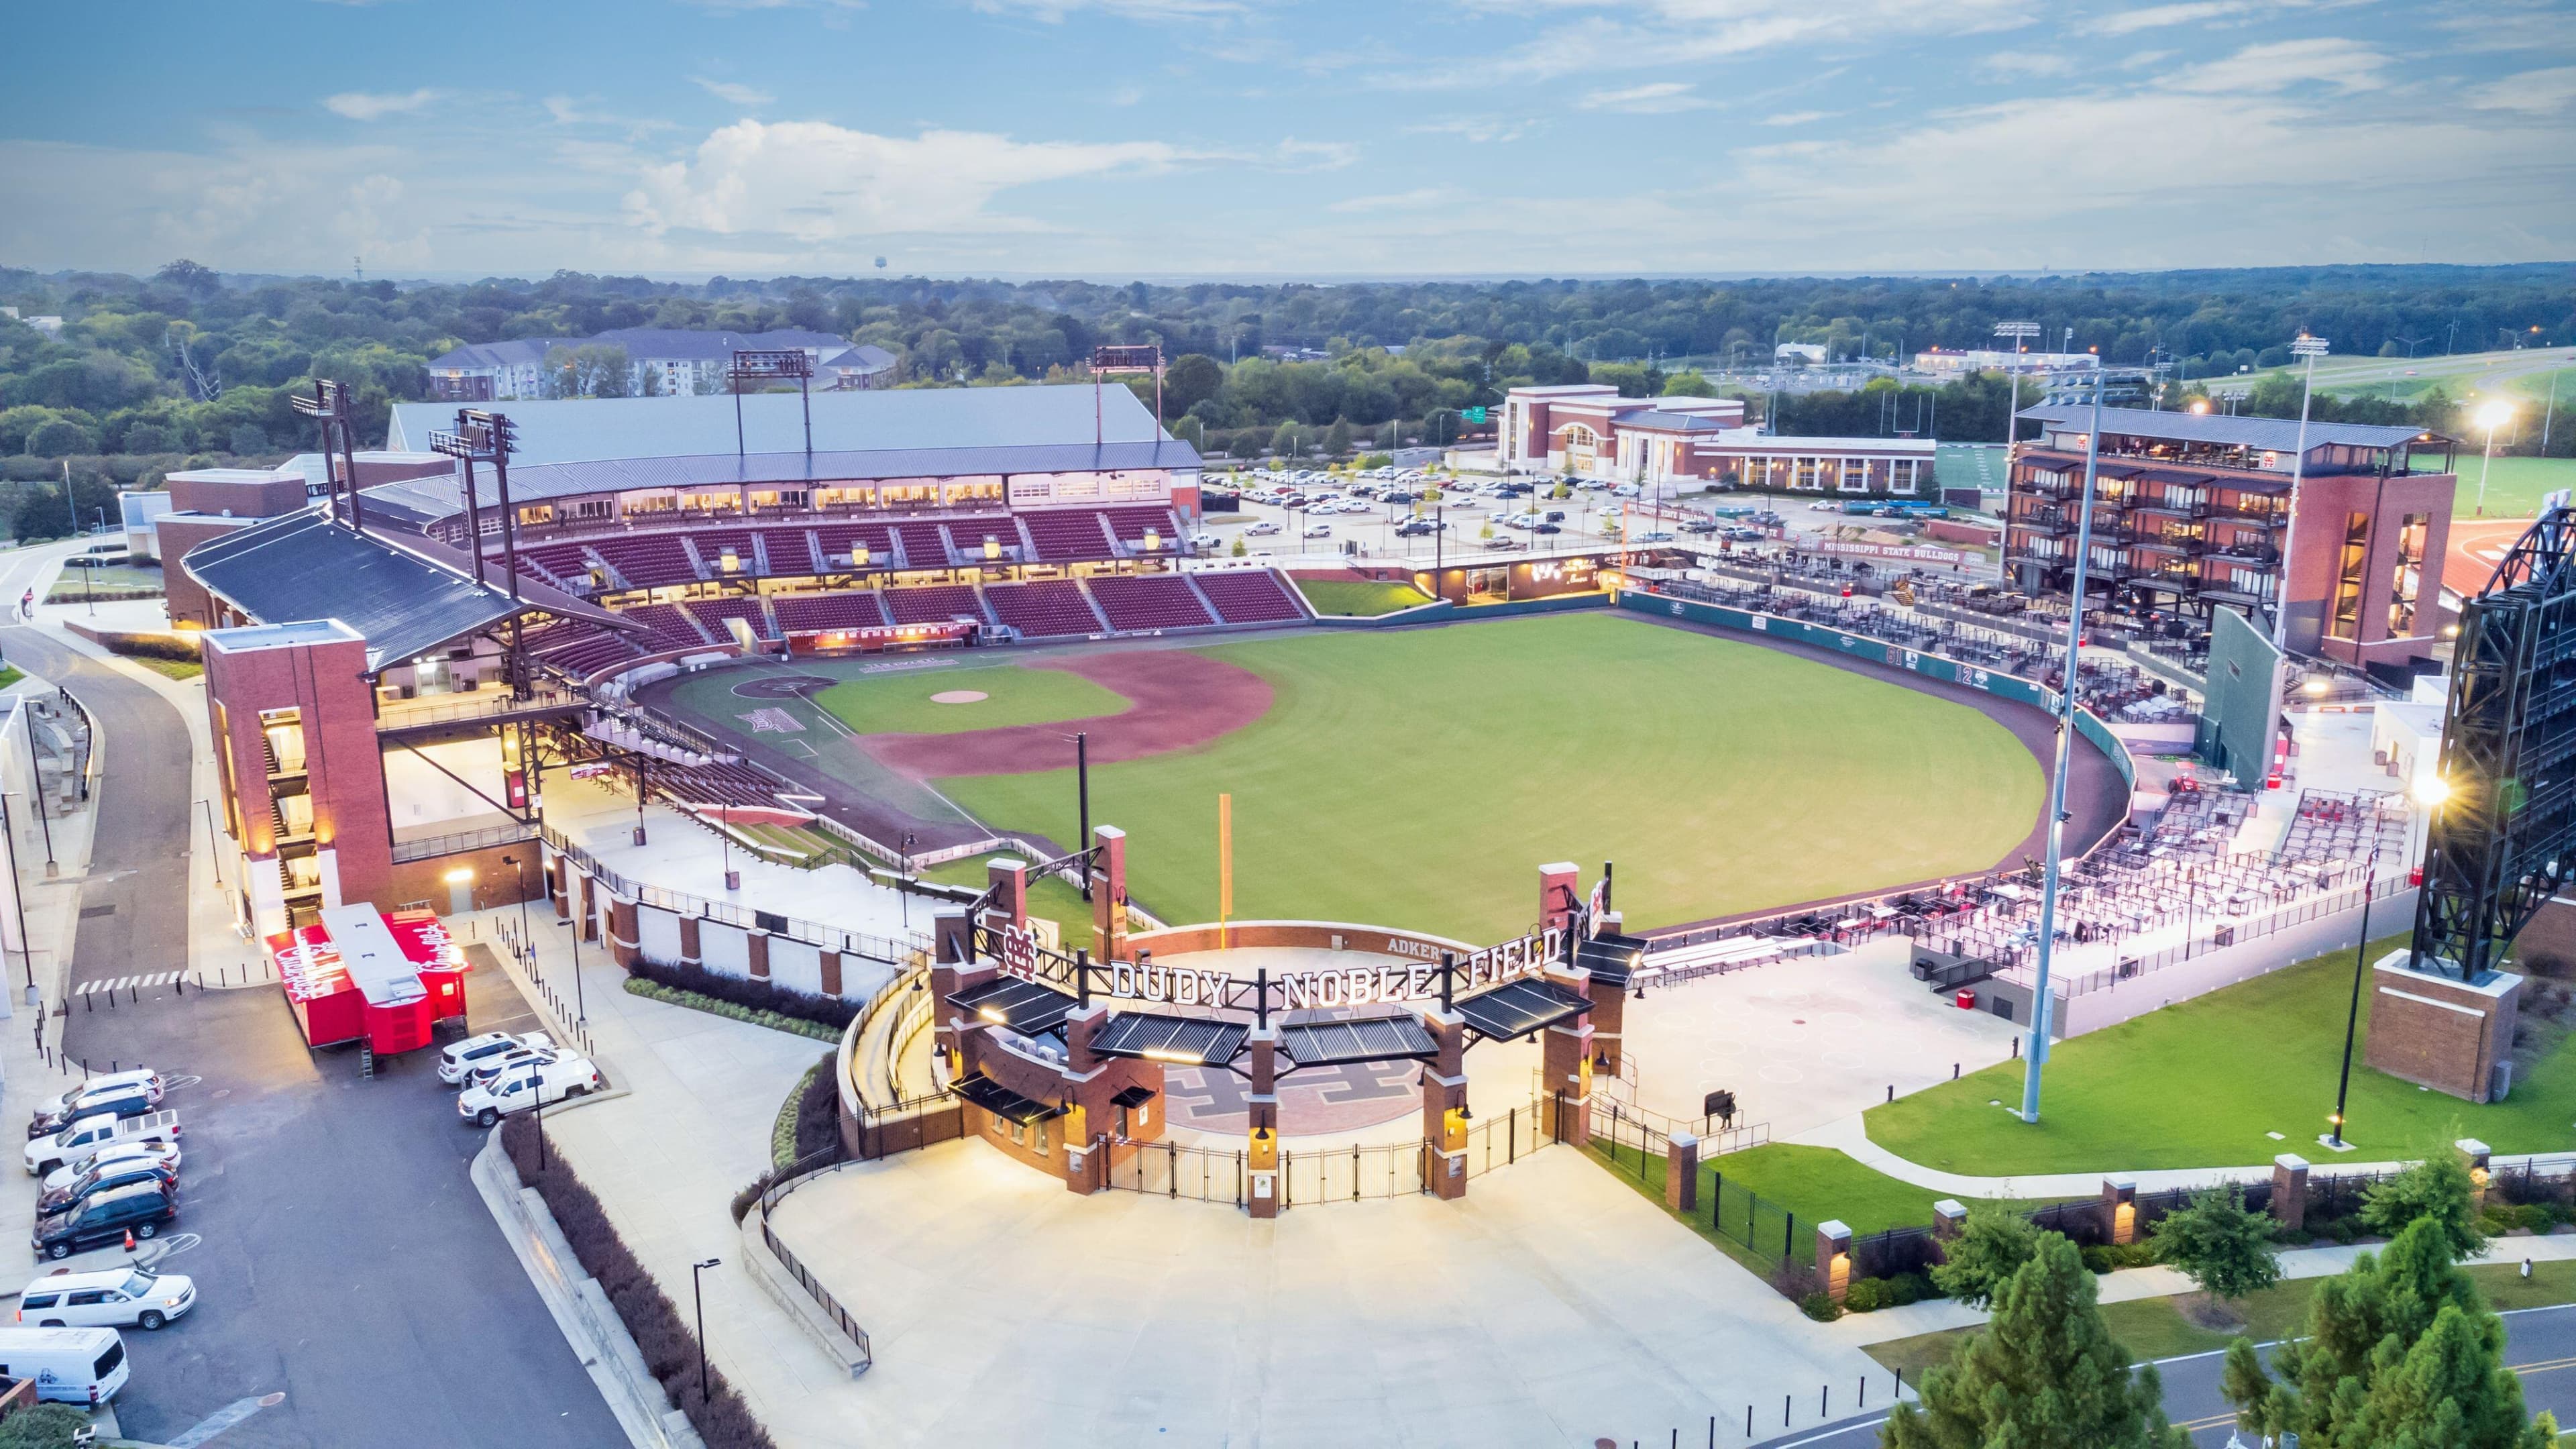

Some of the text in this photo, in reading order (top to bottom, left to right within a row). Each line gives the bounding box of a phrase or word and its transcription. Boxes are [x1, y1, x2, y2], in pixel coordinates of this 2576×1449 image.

[1824, 542, 1959, 561] MISSISSIPPI STATE BULLDOGS
[1886, 646, 1902, 666] 61
[1955, 664, 1972, 685] 12
[1110, 960, 1232, 1008] DUDY
[1281, 962, 1434, 1010] NOBLE
[1468, 925, 1561, 991] FIELD
